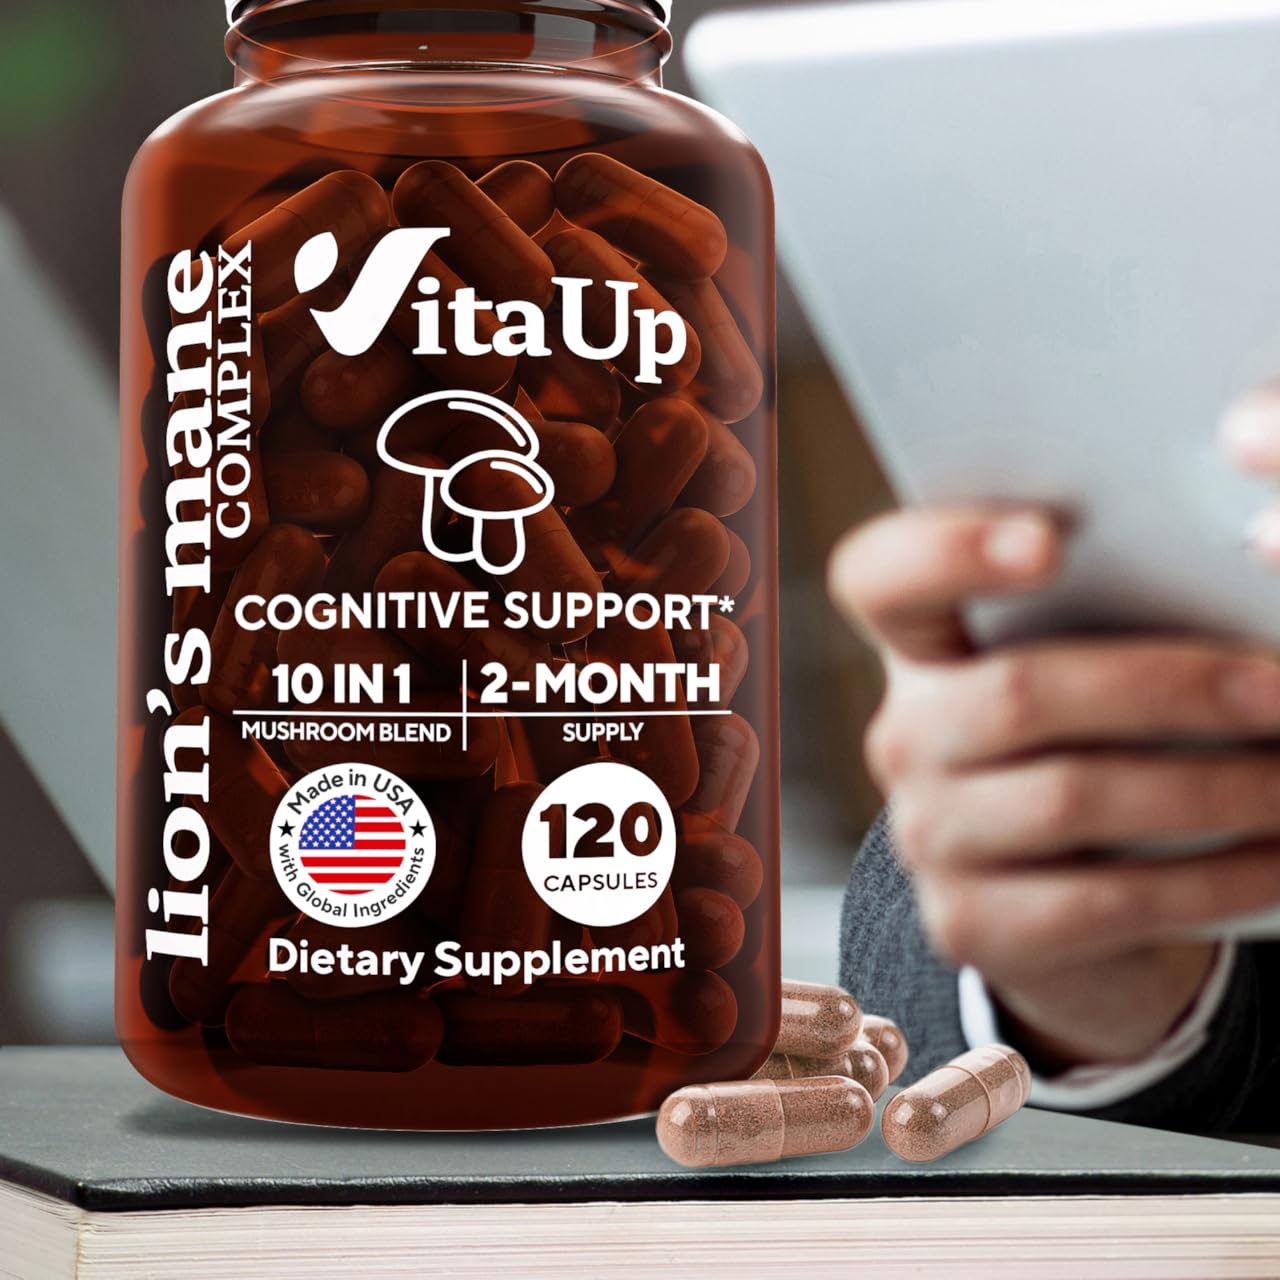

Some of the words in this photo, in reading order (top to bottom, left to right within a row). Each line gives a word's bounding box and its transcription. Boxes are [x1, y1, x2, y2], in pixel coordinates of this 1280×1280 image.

[216, 240, 252, 539] COMPLEX
[164, 249, 215, 596] mane
[234, 591, 490, 630] COGNITIVE
[272, 663, 324, 704] 10
[333, 663, 385, 705] IN
[392, 663, 411, 704] 1
[480, 662, 720, 704] 2-MONTH
[241, 721, 375, 742] MUSHROOM
[379, 722, 451, 743] BLEND
[563, 721, 644, 744] SUPPLY
[287, 773, 344, 815] Made
[349, 768, 367, 787] in
[373, 773, 415, 816] USA
[539, 802, 663, 859] 120
[279, 843, 299, 882] with
[296, 882, 347, 917] Global
[354, 847, 425, 917] Ingredients
[543, 871, 658, 892] CAPSULES
[267, 937, 424, 986] Dietary
[434, 937, 686, 985] Supplement
